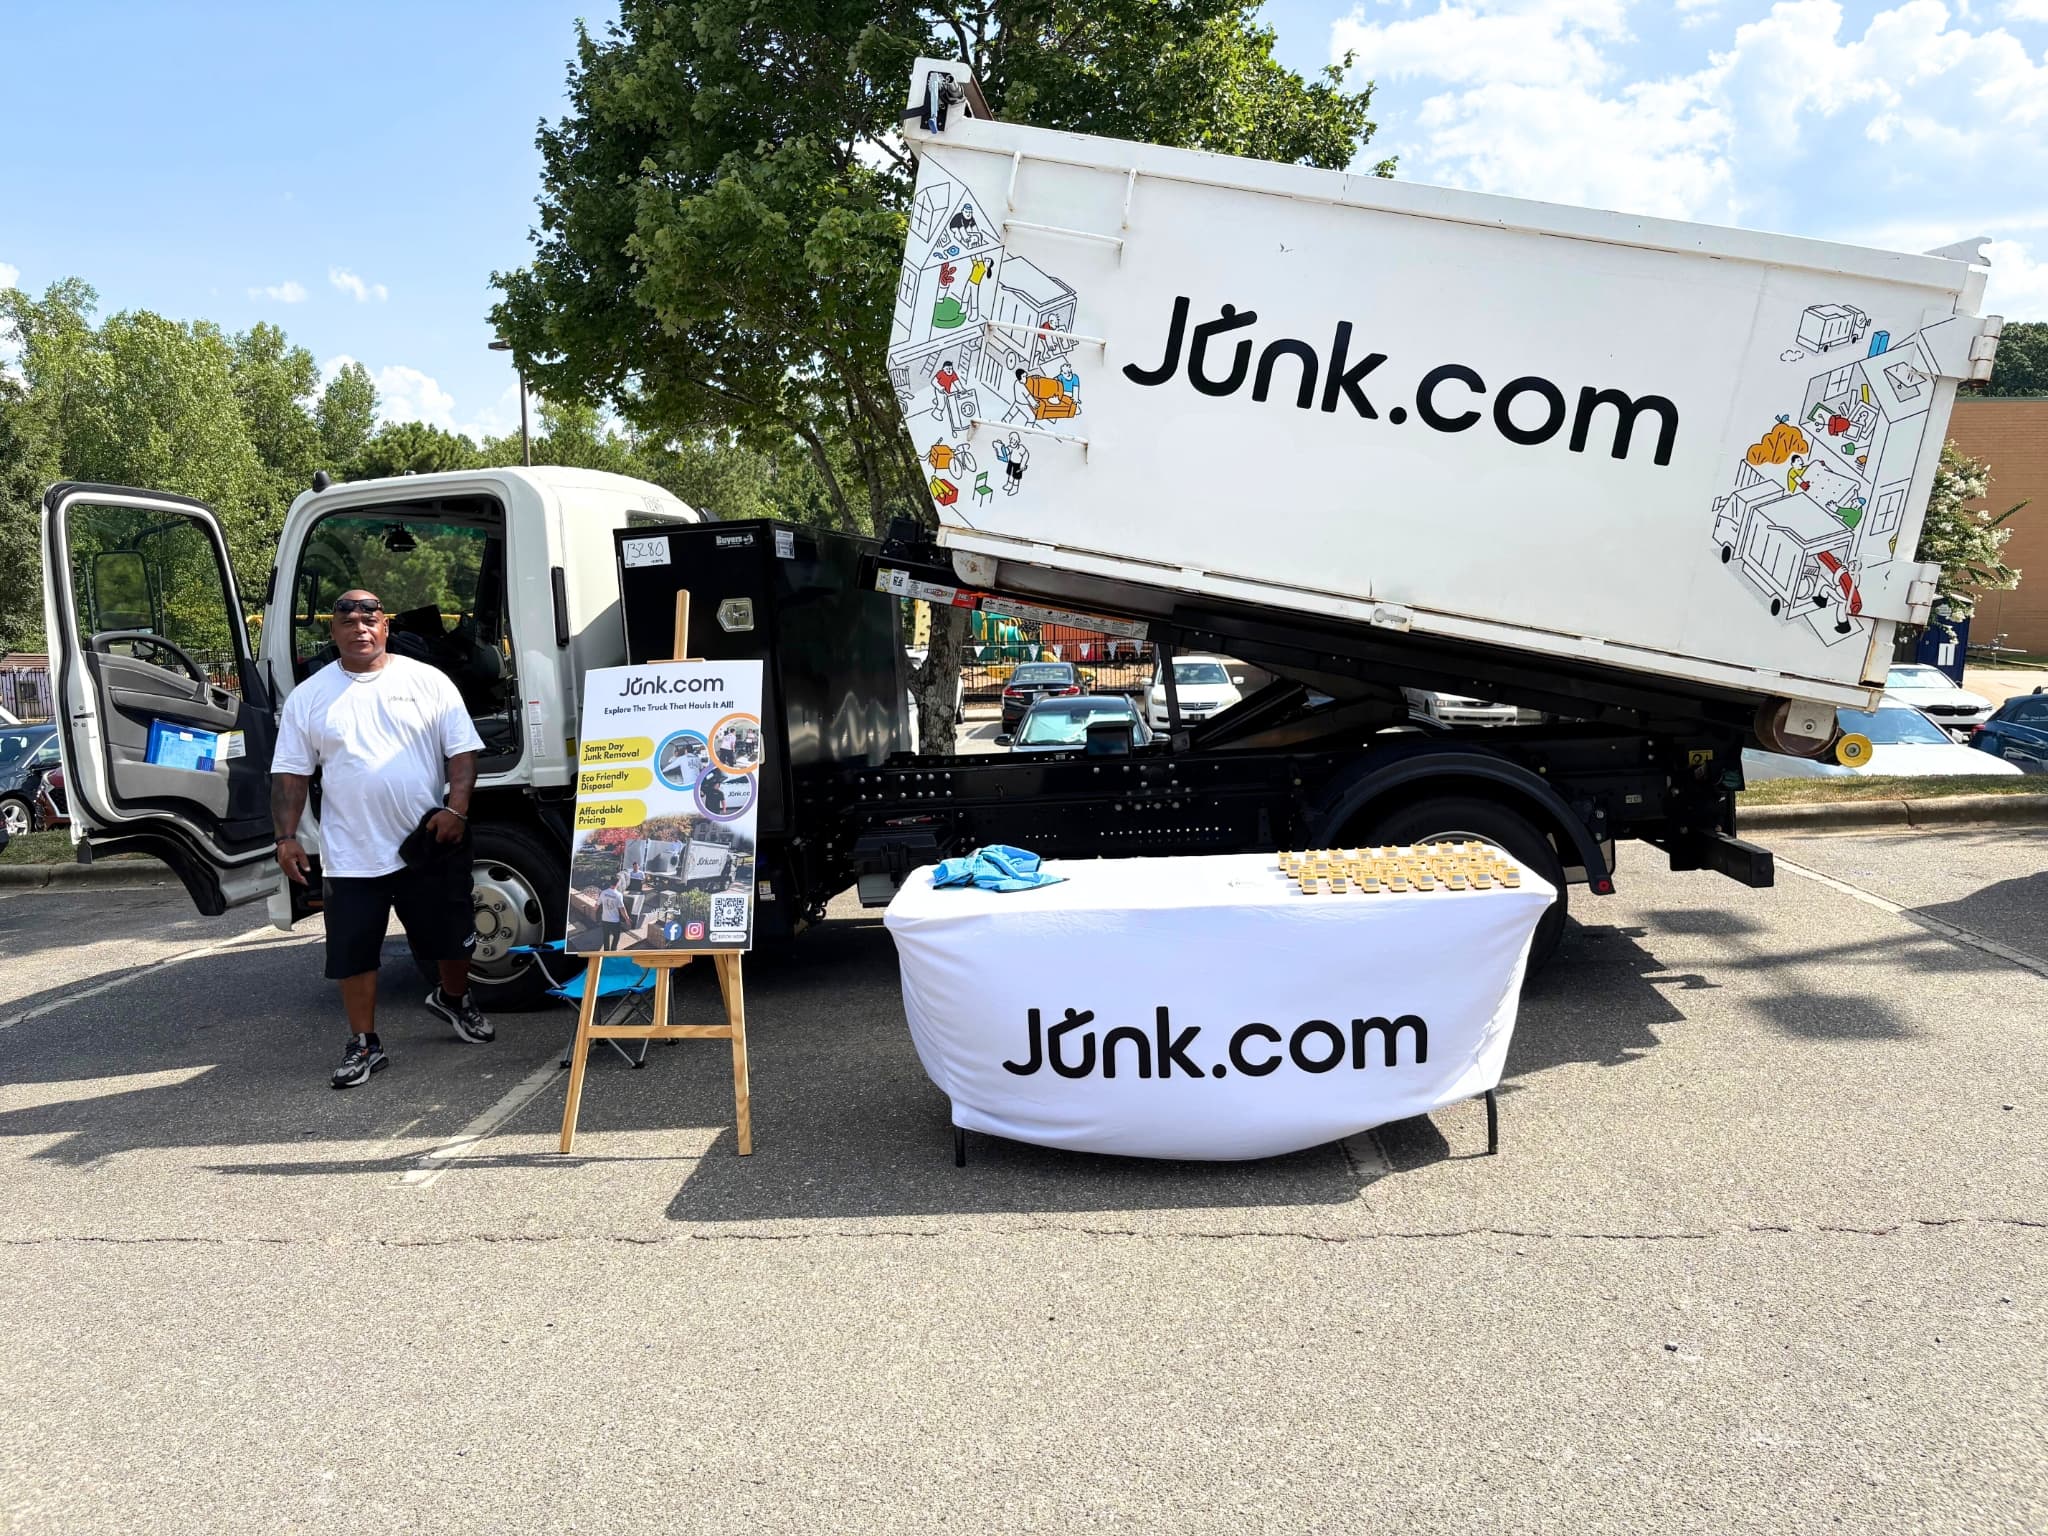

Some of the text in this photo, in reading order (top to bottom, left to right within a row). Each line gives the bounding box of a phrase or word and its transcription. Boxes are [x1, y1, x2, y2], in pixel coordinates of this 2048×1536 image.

[1122, 296, 1679, 466] Junk.com
[625, 541, 665, 560] 13280
[619, 675, 724, 696] Junk.com
[604, 705, 631, 715] Explore
[633, 704, 646, 712] The
[647, 703, 668, 711] Truck
[669, 702, 687, 710] That
[688, 701, 711, 710] Hauls
[713, 701, 718, 709] It
[585, 742, 624, 753] Same Day
[584, 748, 640, 761] Junk Removal
[581, 771, 629, 782] Eco Friendly
[581, 780, 613, 792] Disposal
[579, 805, 623, 815] Affordable
[578, 816, 606, 825] Pricing
[1002, 1006, 1428, 1079] Junk.com
